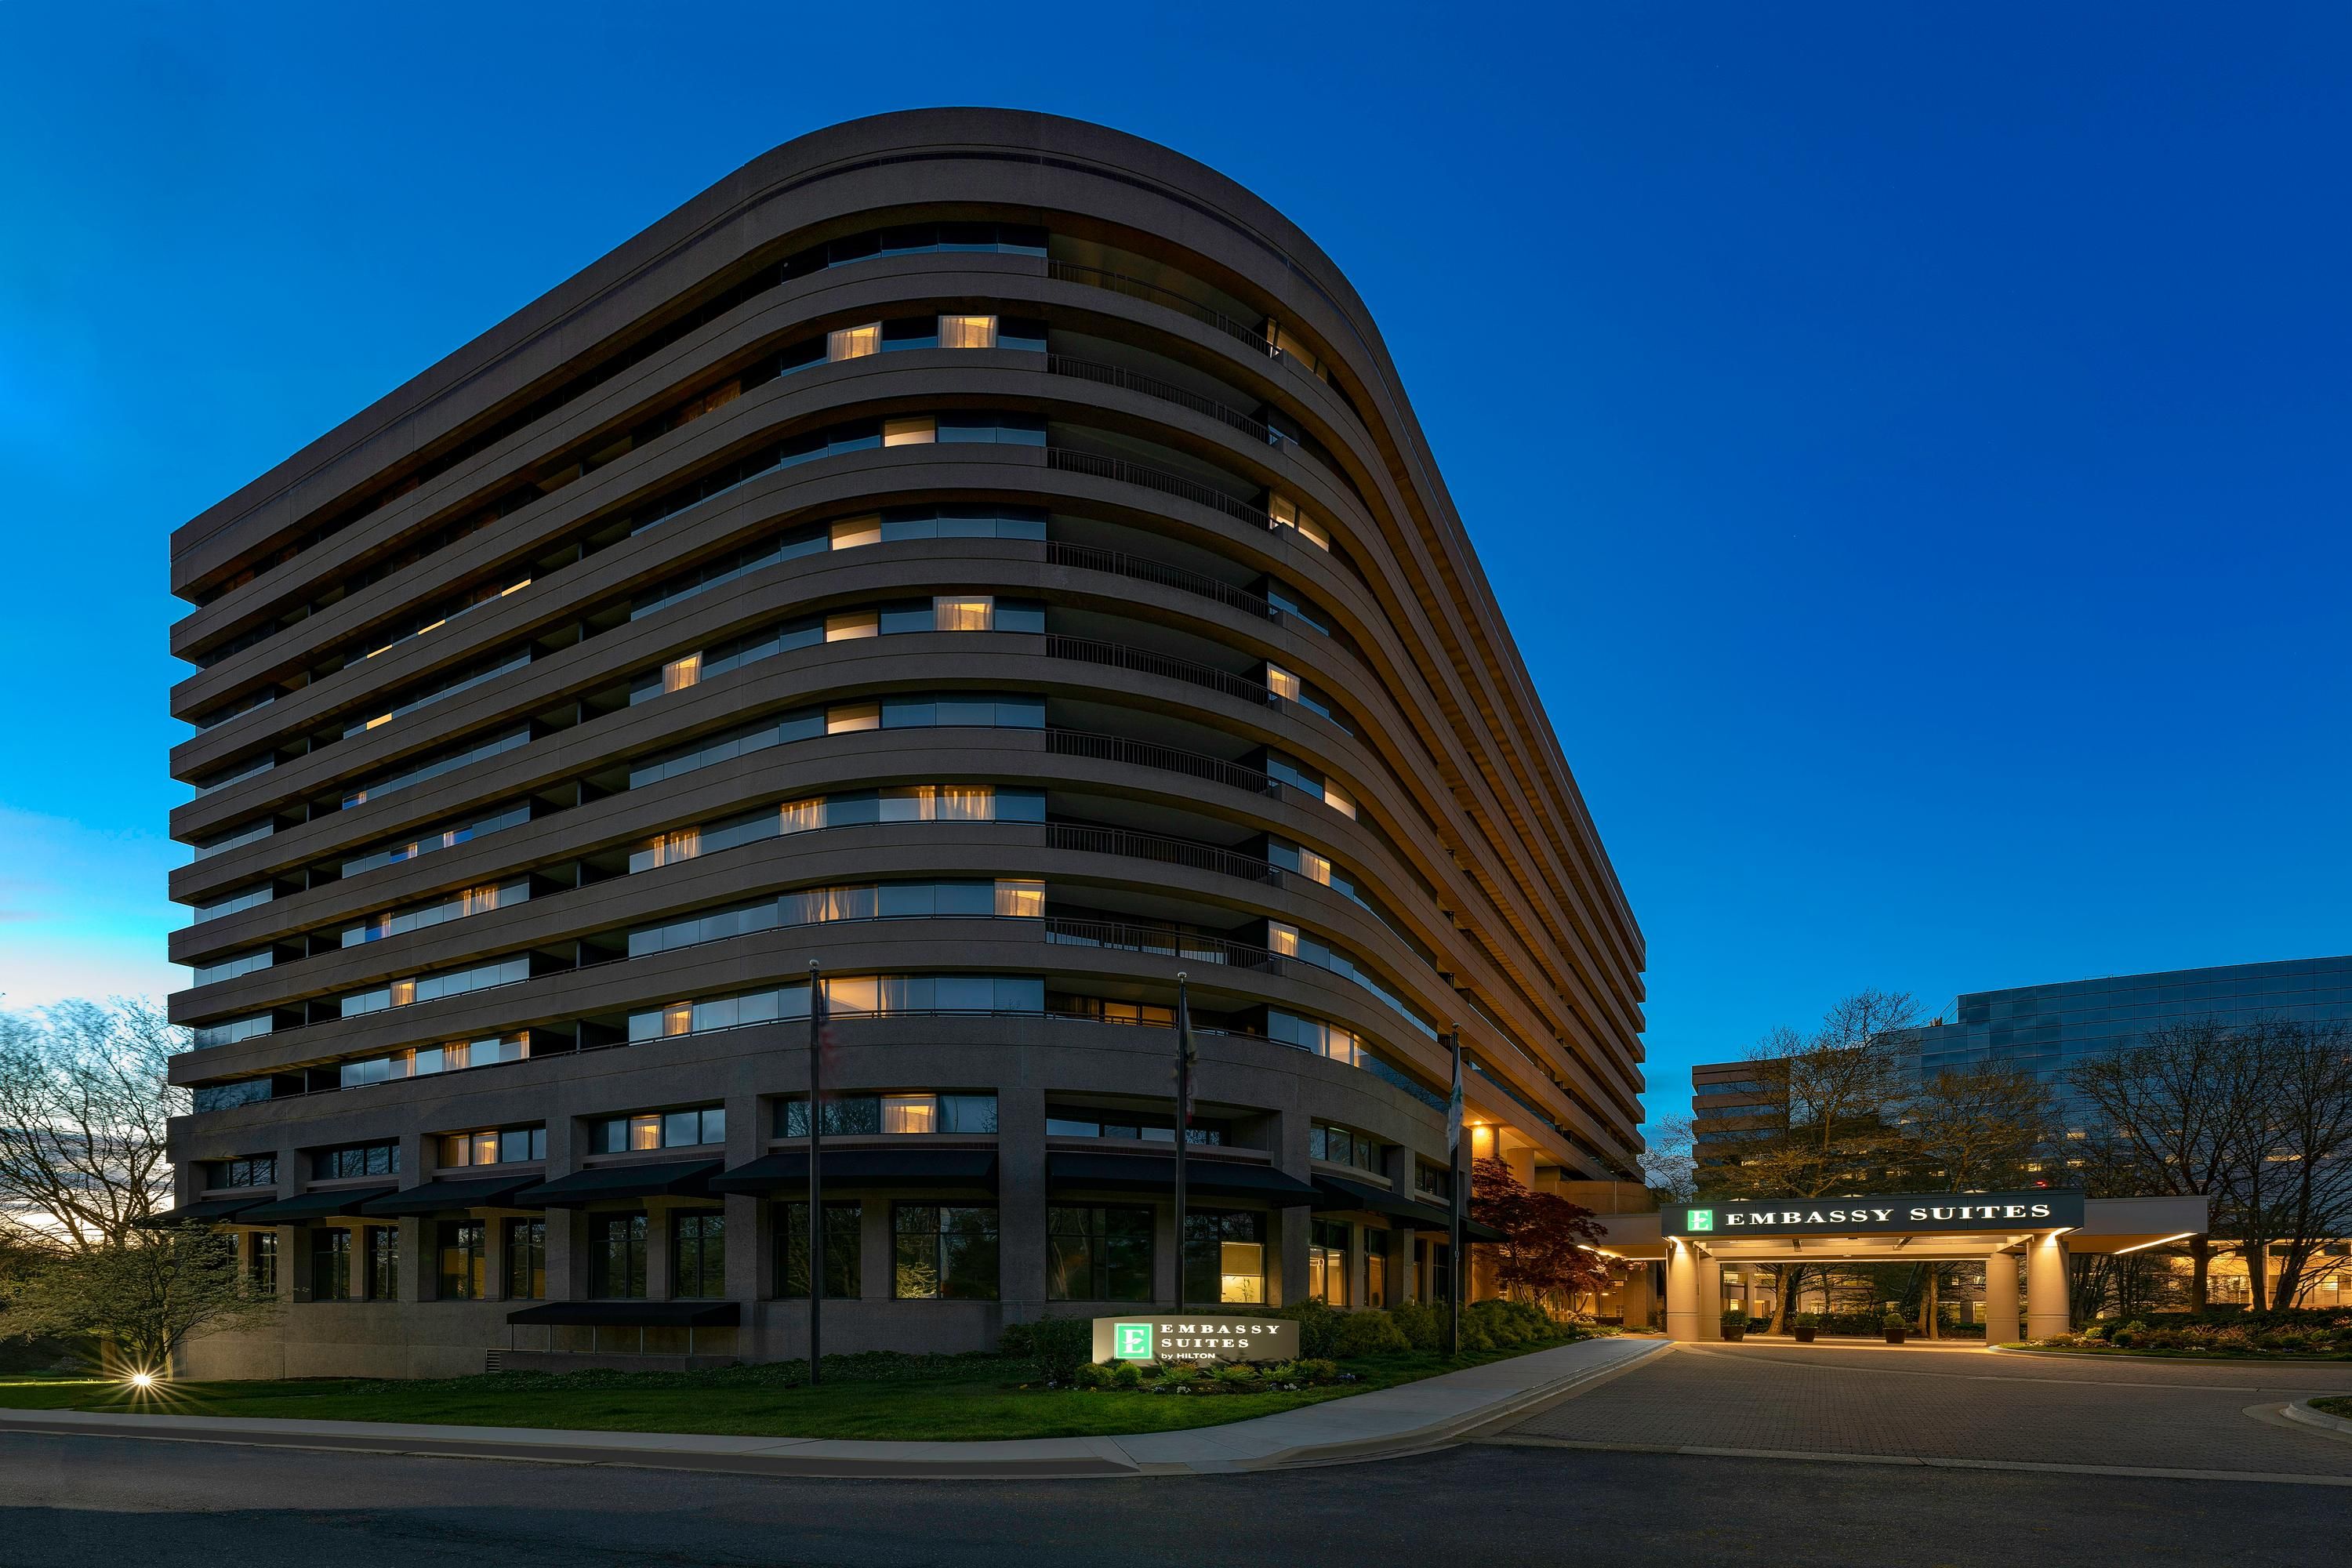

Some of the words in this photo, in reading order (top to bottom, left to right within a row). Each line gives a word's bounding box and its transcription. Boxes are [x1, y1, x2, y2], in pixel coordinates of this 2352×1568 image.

[1725, 1208, 1894, 1225] EMBASSY
[1910, 1203, 2050, 1221] SUITES
[1160, 1323, 1279, 1334] EMBASSY
[1161, 1338, 1249, 1348] SUITES
